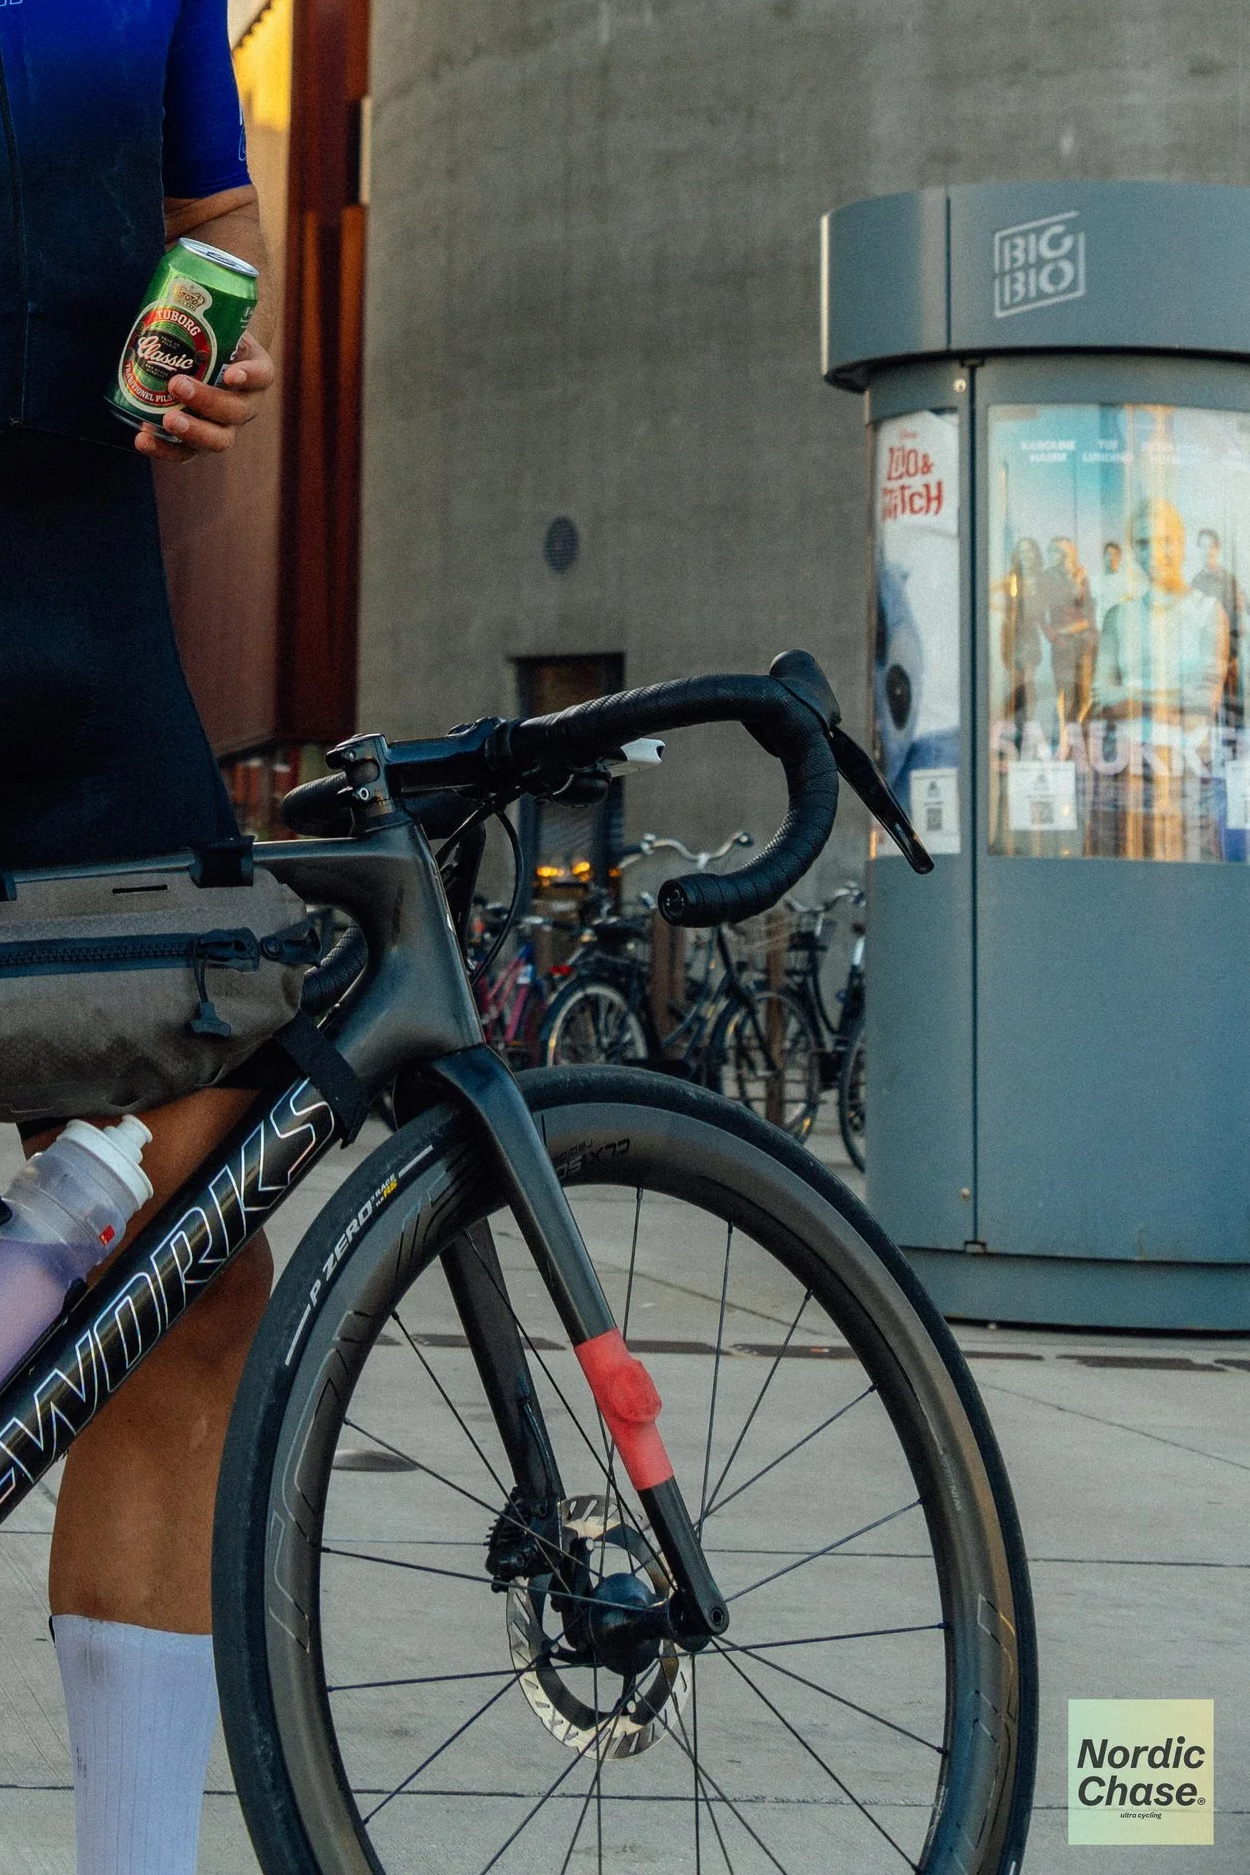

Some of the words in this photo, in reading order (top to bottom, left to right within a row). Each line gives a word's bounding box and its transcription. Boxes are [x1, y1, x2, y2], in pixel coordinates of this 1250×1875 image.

[1004, 225, 1074, 271] BIG
[1004, 258, 1074, 305] BIO
[156, 309, 201, 336] TUBORG
[138, 335, 194, 369] Classic
[310, 1279, 322, 1307] P
[322, 1199, 373, 1282] ZERO
